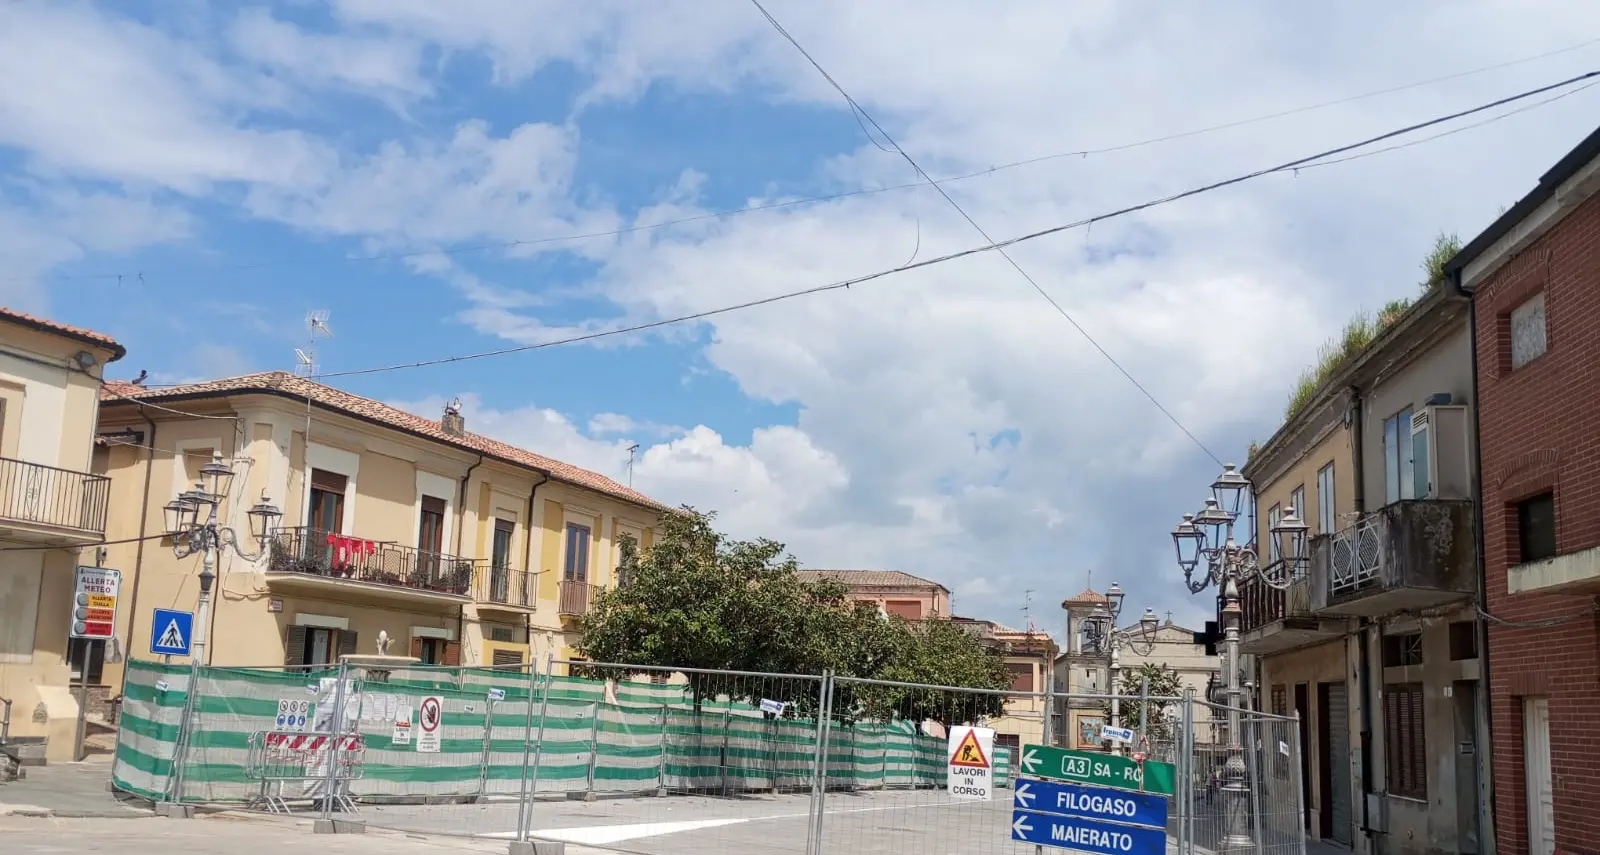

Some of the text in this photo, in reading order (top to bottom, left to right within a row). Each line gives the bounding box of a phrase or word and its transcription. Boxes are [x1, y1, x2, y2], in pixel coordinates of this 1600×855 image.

[81, 576, 115, 587] ALLERTA
[84, 585, 111, 593] METEO
[953, 767, 986, 777] LAVORI
[1066, 759, 1085, 774] A3
[1094, 762, 1111, 777] SA
[964, 777, 974, 785] IN
[952, 786, 986, 796] CORSO
[1057, 791, 1136, 817] FILOGASO
[1051, 823, 1133, 851] MAIERATO
